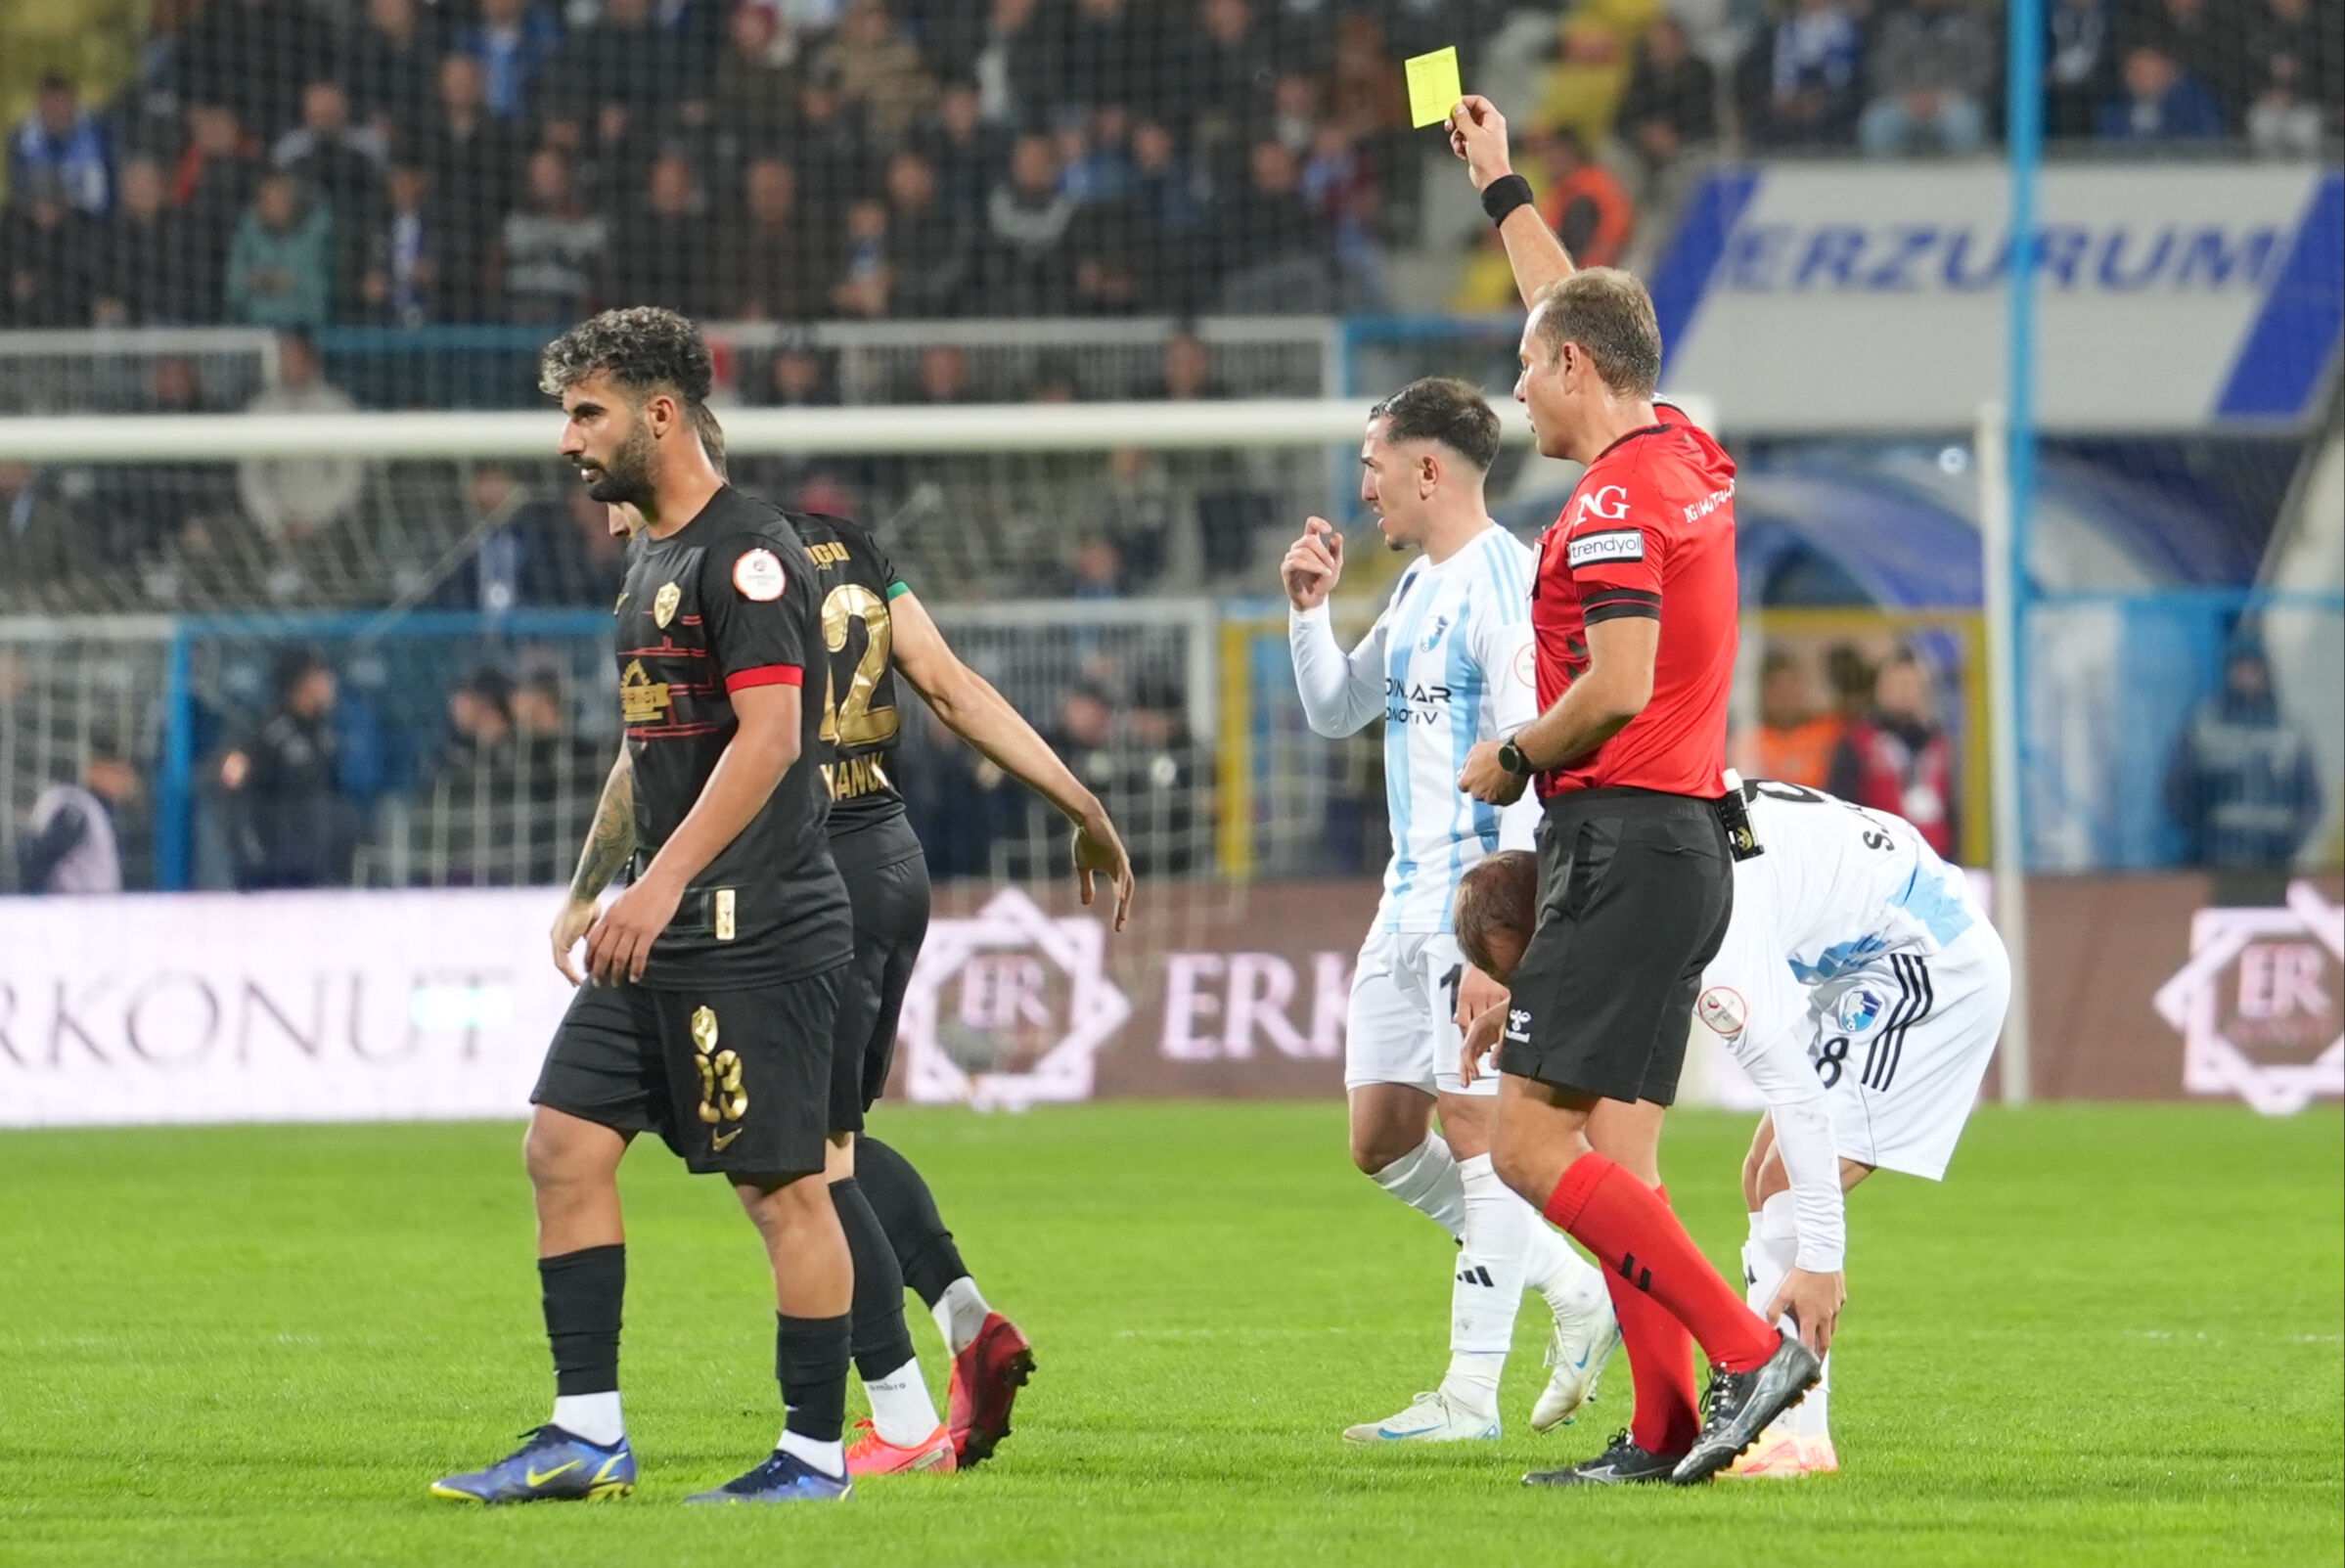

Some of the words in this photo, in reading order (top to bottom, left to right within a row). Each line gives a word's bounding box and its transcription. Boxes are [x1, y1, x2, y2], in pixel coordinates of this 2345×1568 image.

[1574, 485, 1631, 526] NG
[1571, 536, 1642, 560] trendyol
[819, 584, 898, 746] 2
[695, 1050, 748, 1124] 13
